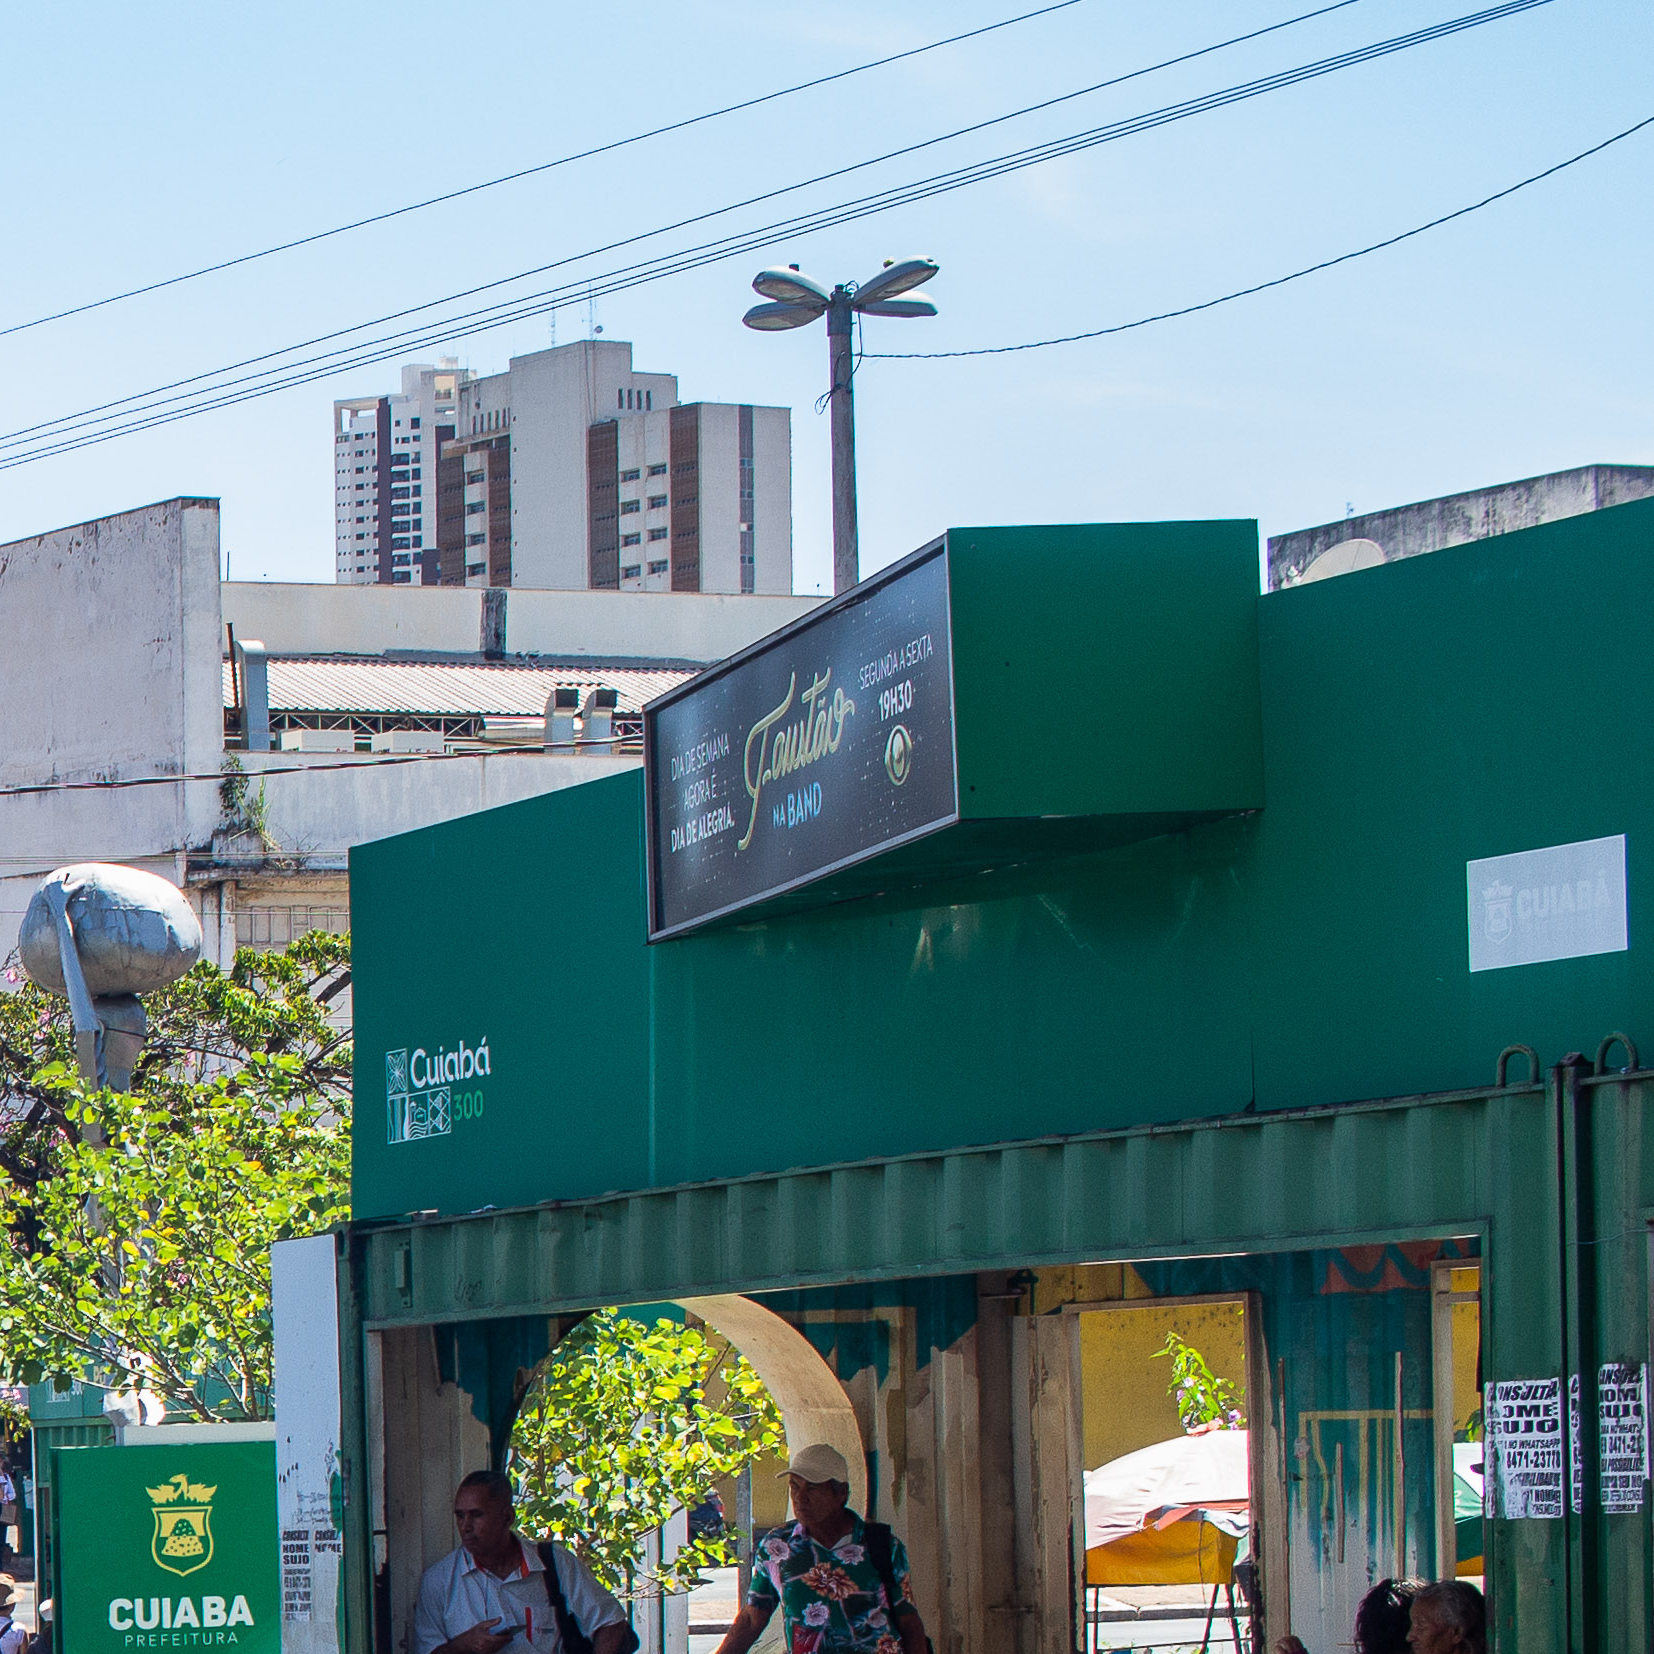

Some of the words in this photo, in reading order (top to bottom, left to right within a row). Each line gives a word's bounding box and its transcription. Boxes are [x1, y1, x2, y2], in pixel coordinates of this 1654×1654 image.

[859, 650, 898, 690] SEGUNDA
[906, 633, 933, 666] SEXTA
[878, 680, 912, 721] 19H30
[671, 754, 685, 781] DIA
[685, 750, 696, 776] DE
[696, 734, 730, 768] SEMANA
[738, 666, 855, 850] Faustão
[683, 782, 711, 811] AGORA
[772, 806, 786, 829] NA
[787, 782, 822, 829] BAND
[671, 825, 686, 852] DIA
[686, 822, 697, 846] DE
[411, 1035, 491, 1089] Cuiabá
[454, 1090, 483, 1121] 300
[282, 1543, 309, 1553] NOME
[283, 1555, 309, 1565] SUJO
[108, 1594, 255, 1631] CUIABA
[124, 1631, 239, 1648] PREFEITURA
